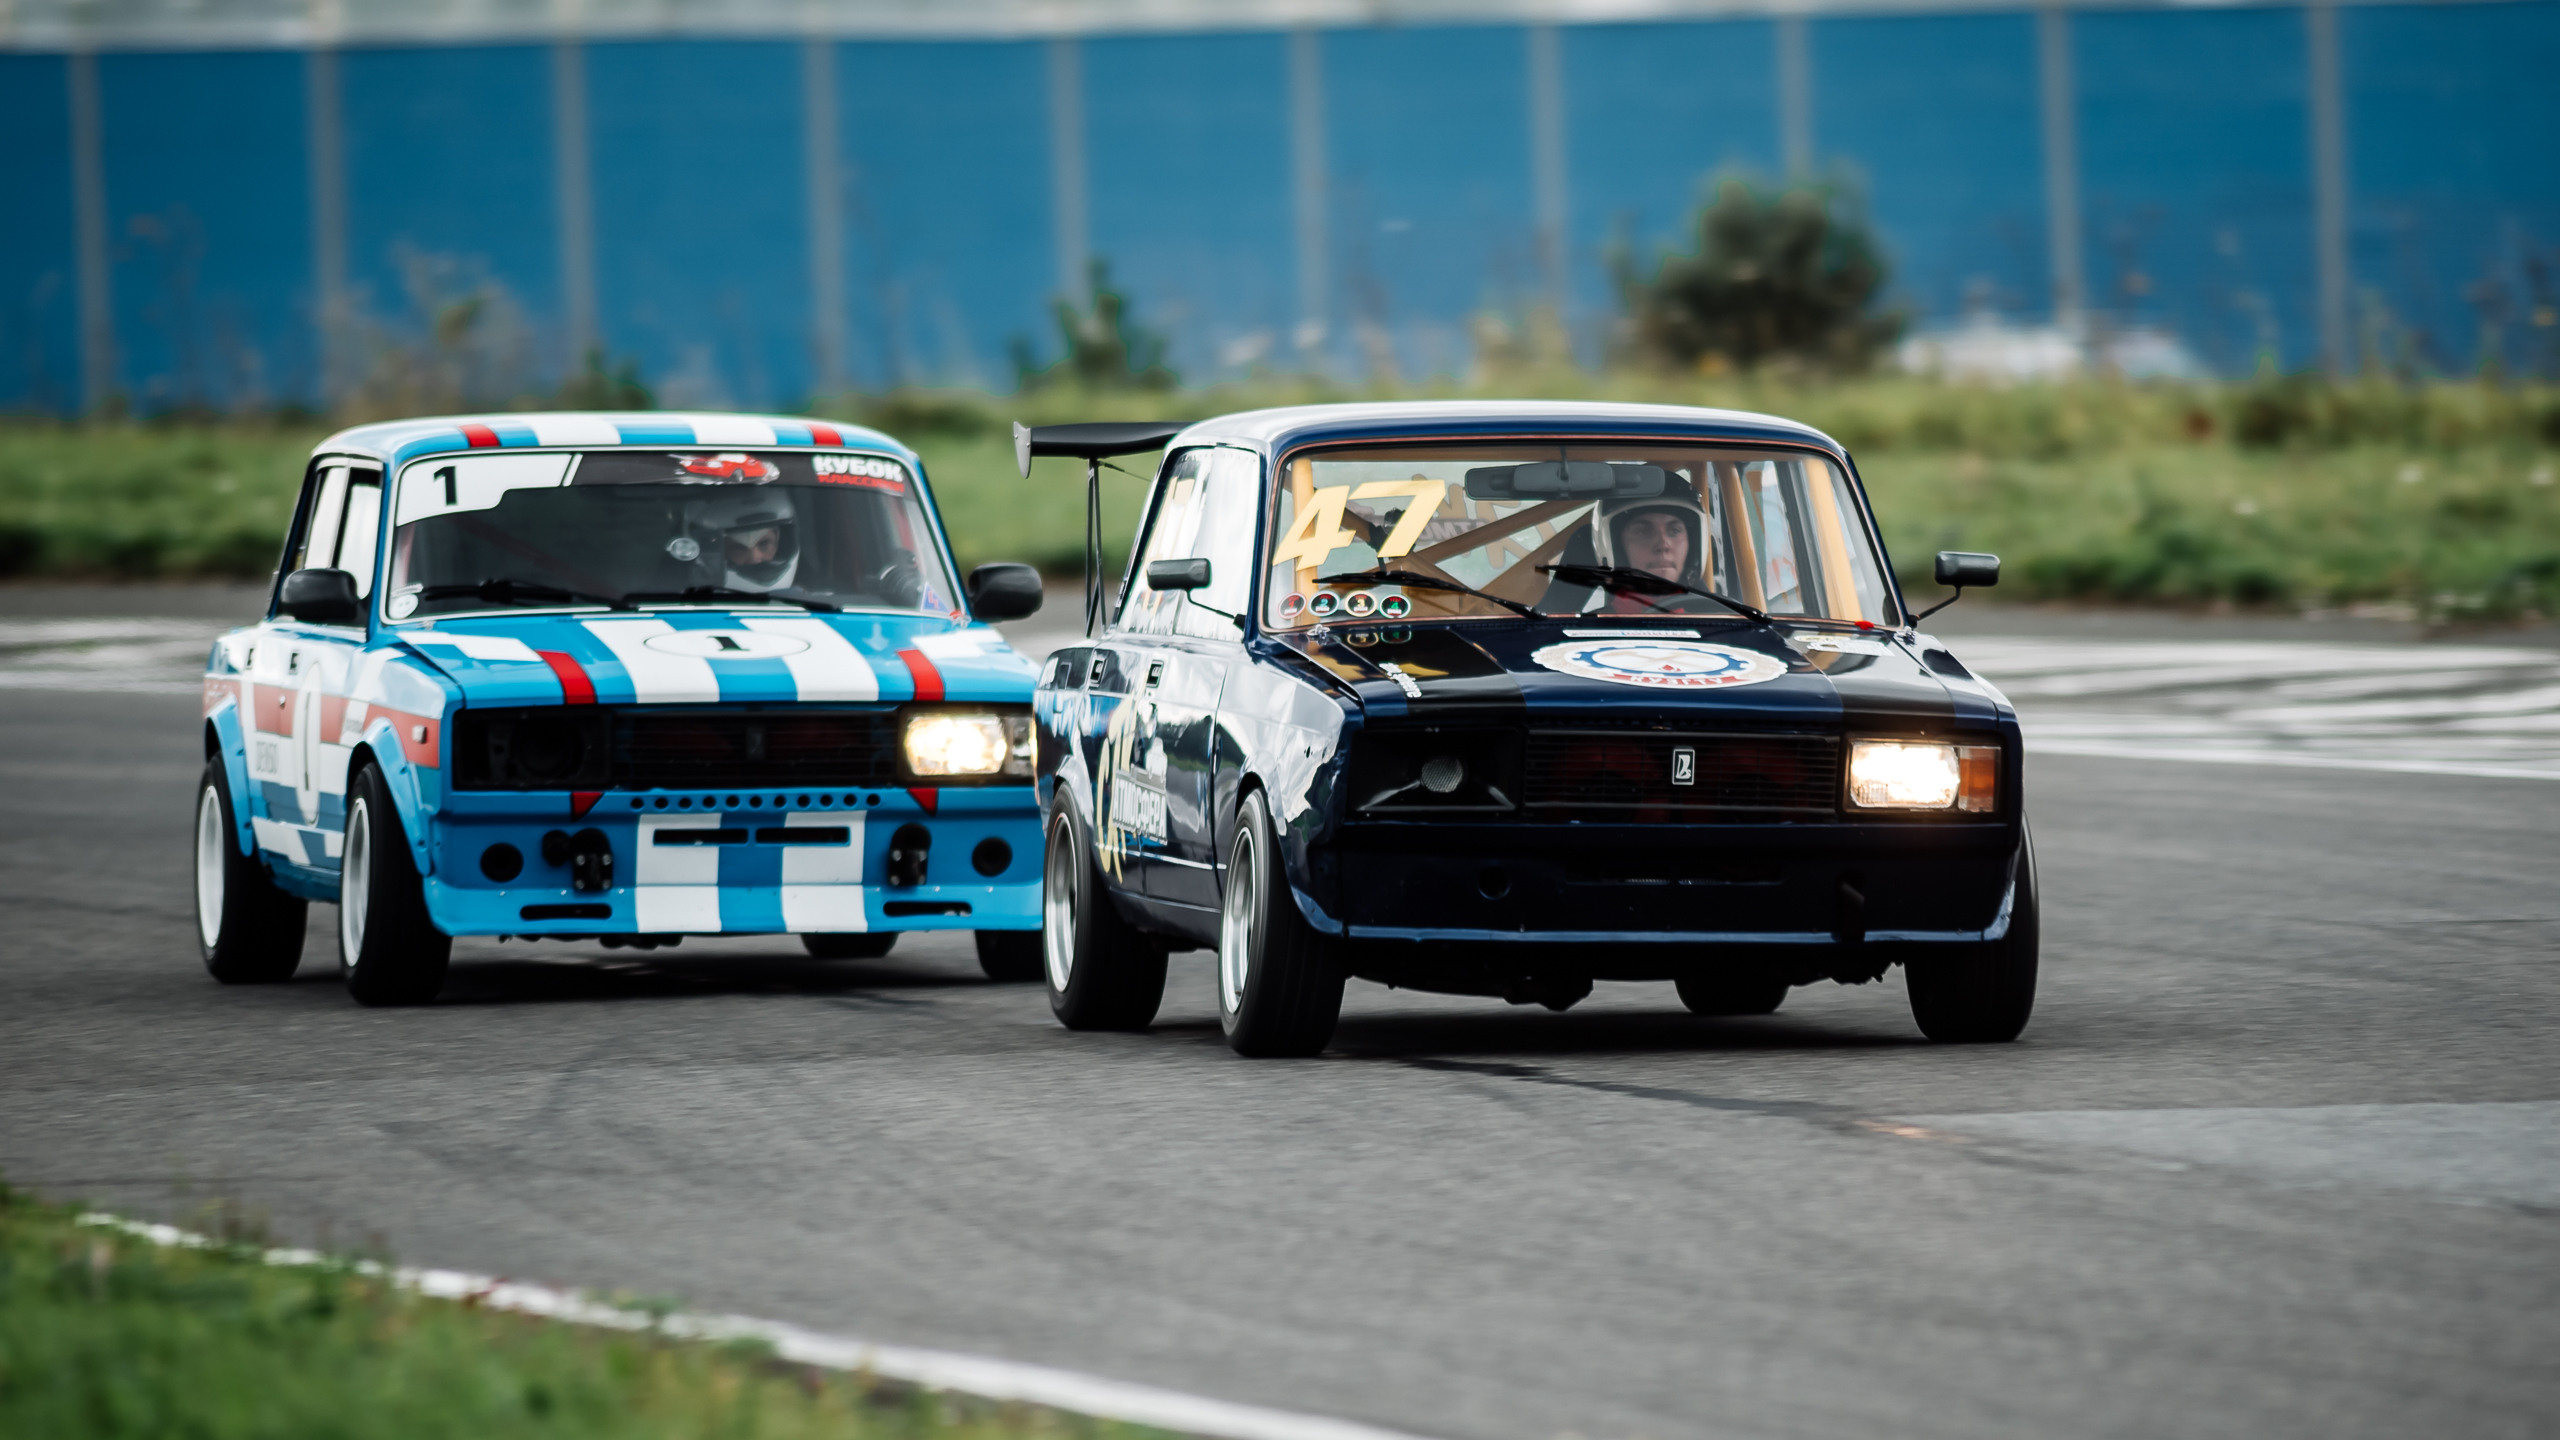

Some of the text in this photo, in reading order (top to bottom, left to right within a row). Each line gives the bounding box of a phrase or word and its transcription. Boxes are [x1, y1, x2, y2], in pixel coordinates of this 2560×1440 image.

[433, 465, 459, 506] 1
[812, 455, 904, 482] КУБОК
[1272, 480, 1446, 572] 47
[1390, 601, 1400, 610] 4
[706, 636, 751, 652] 1
[1112, 776, 1167, 839] АТМОСФЕРА
